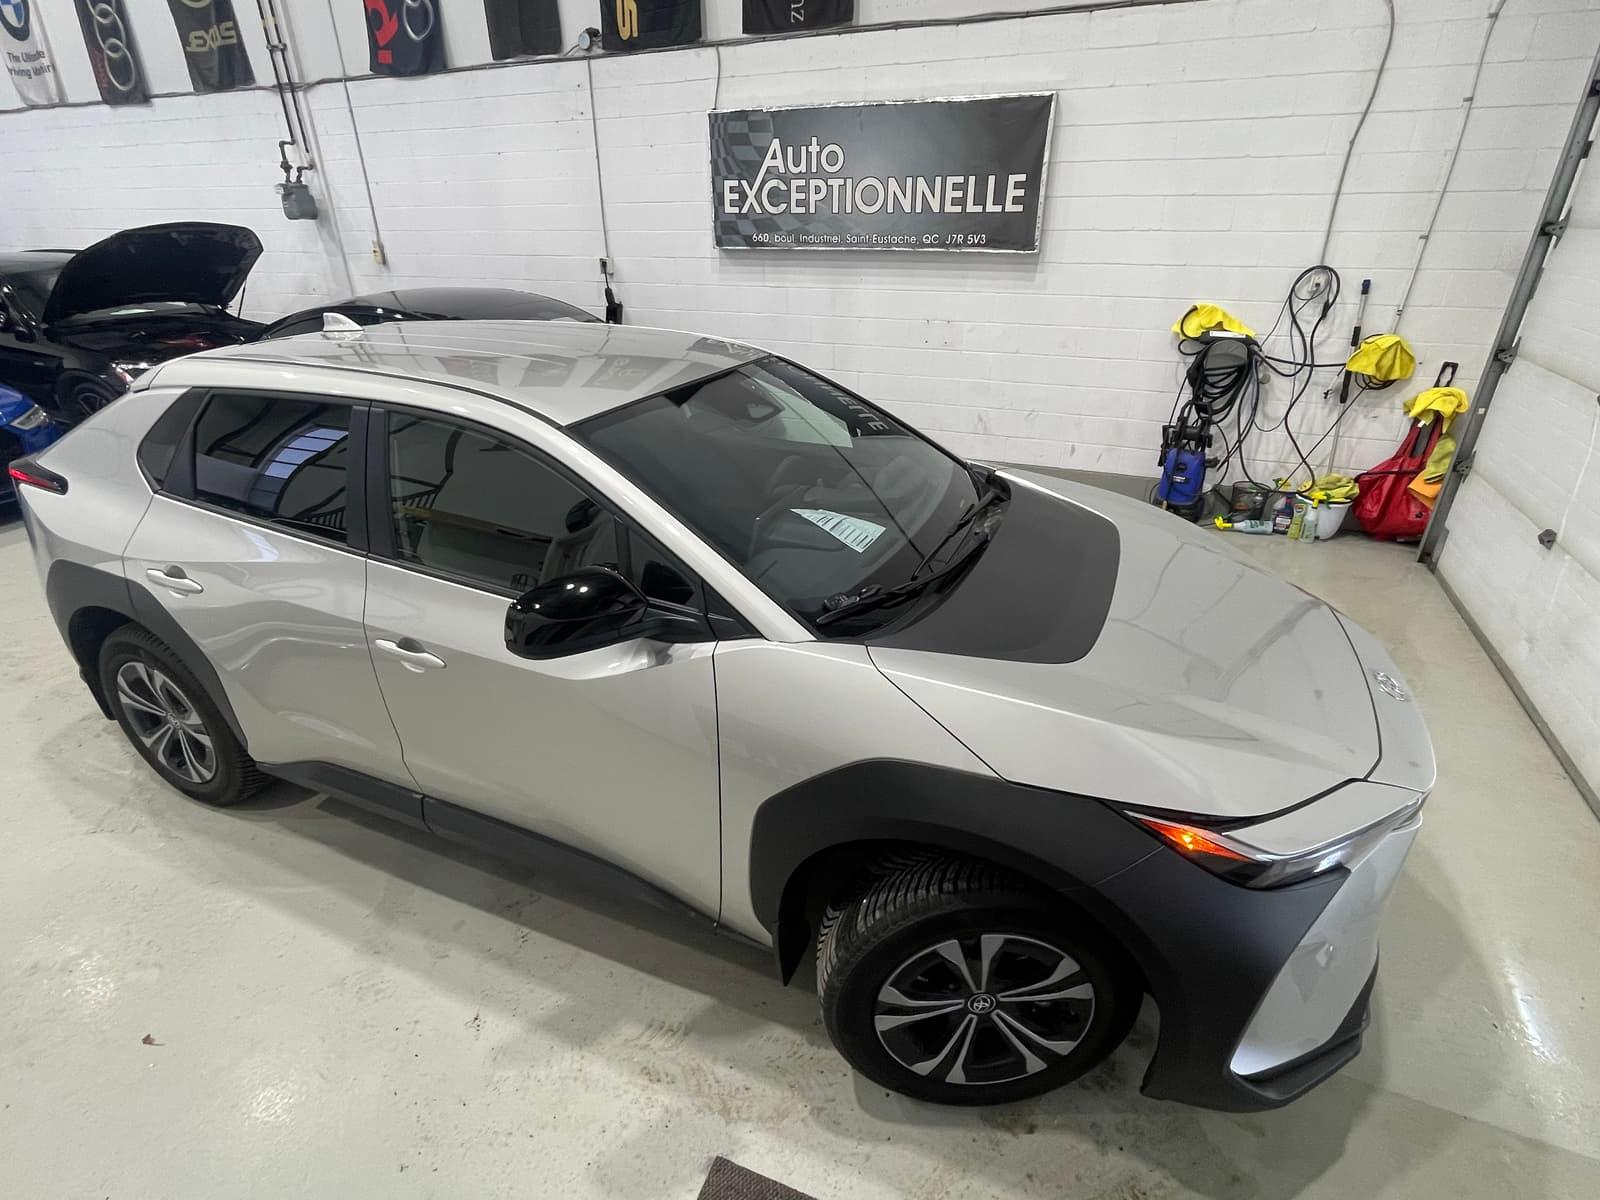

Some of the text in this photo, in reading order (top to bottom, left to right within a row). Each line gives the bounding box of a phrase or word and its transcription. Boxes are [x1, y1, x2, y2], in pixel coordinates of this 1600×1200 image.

[755, 136, 845, 174] Auto
[723, 175, 1026, 215] EXCEPTIONNELLE
[922, 233, 940, 244] QC
[945, 234, 964, 245] J7R
[967, 234, 986, 244] 5V3
